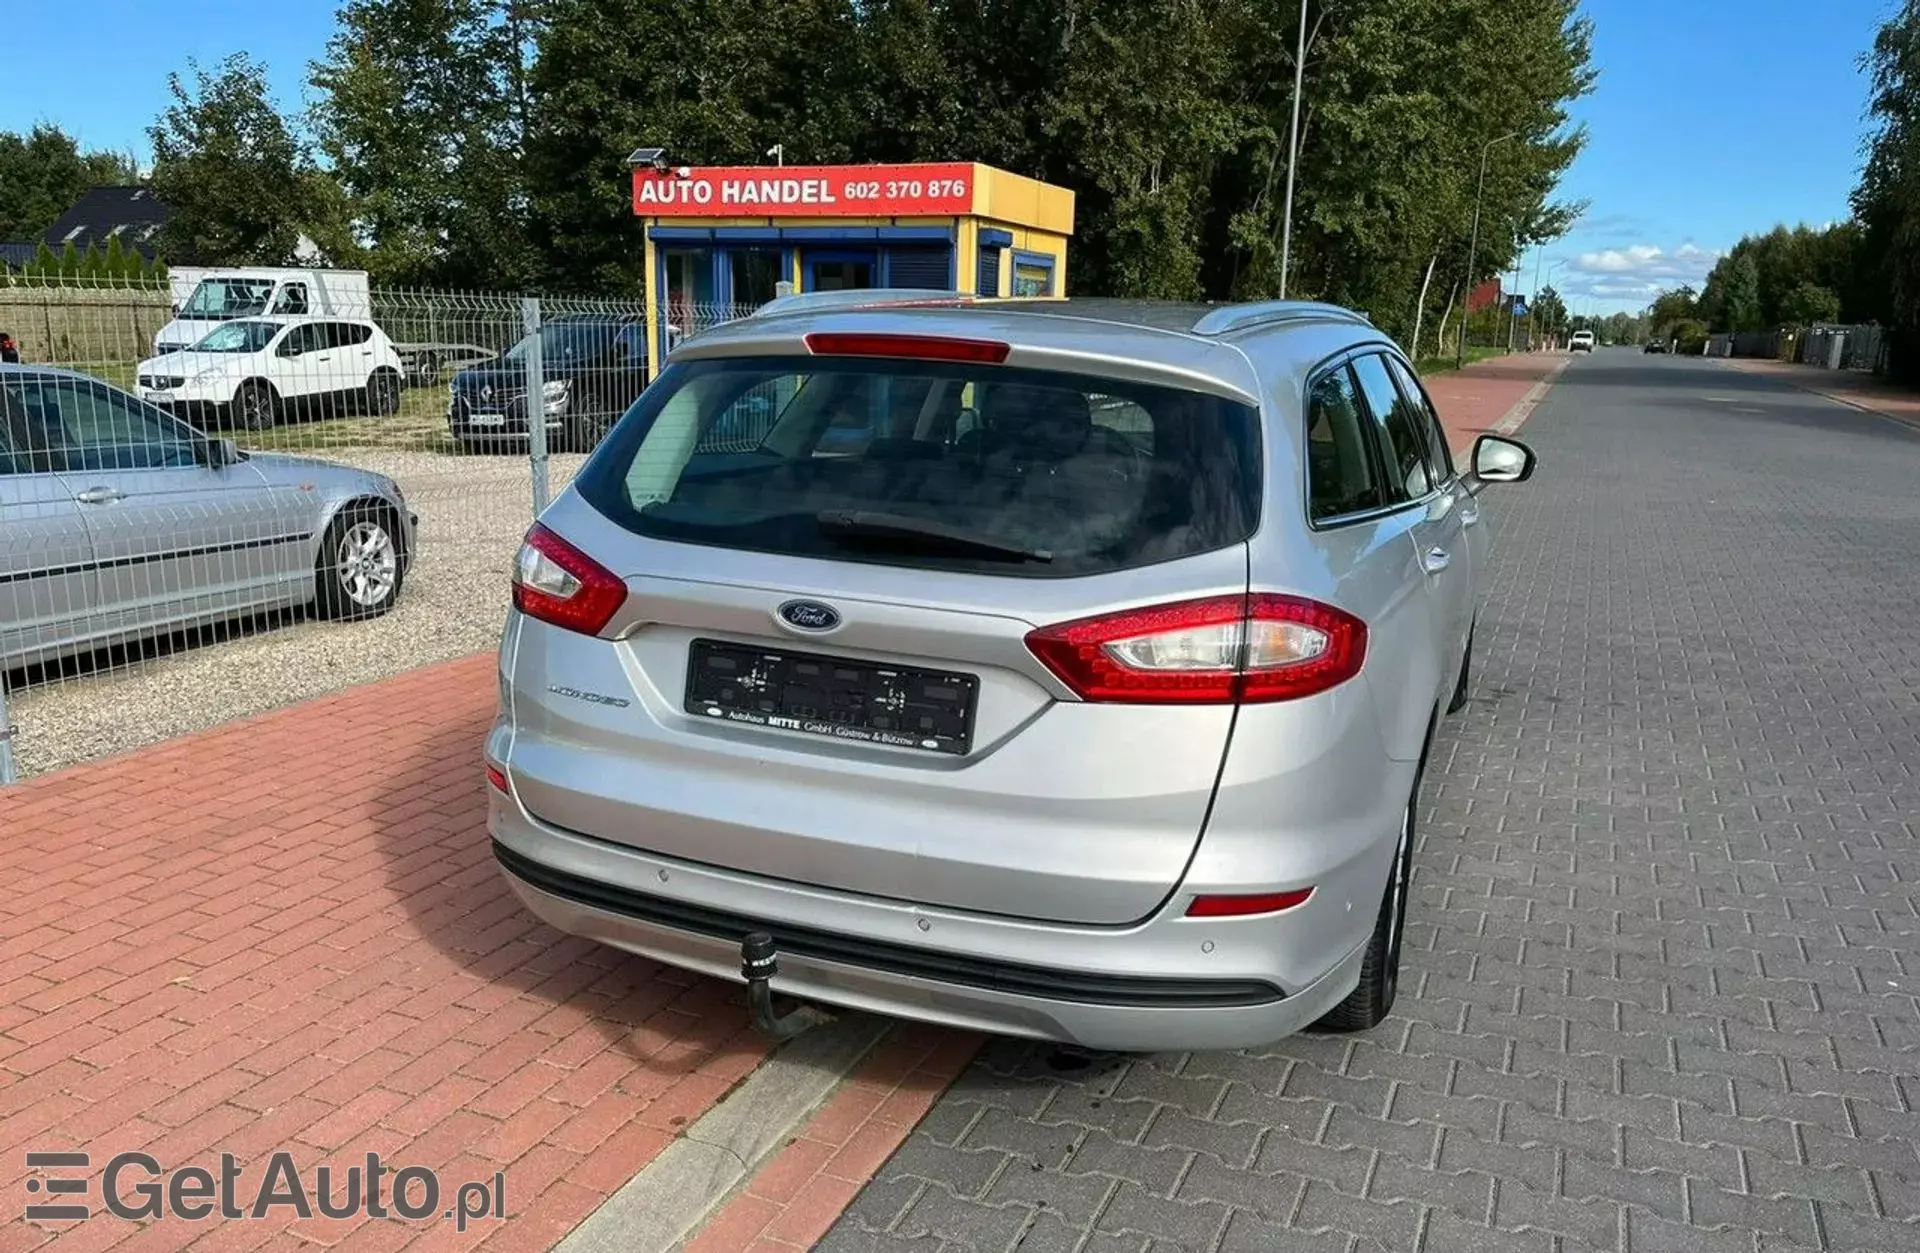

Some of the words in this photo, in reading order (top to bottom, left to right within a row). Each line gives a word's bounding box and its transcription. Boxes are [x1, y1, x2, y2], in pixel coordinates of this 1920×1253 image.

[640, 180, 712, 203] AUTO
[722, 180, 836, 203] HANDEL
[844, 182, 879, 199] 602
[886, 181, 921, 198] 370
[927, 180, 965, 198] 876
[791, 606, 826, 625] Ford
[728, 711, 765, 724] Autohaus
[768, 716, 800, 729] MITTE
